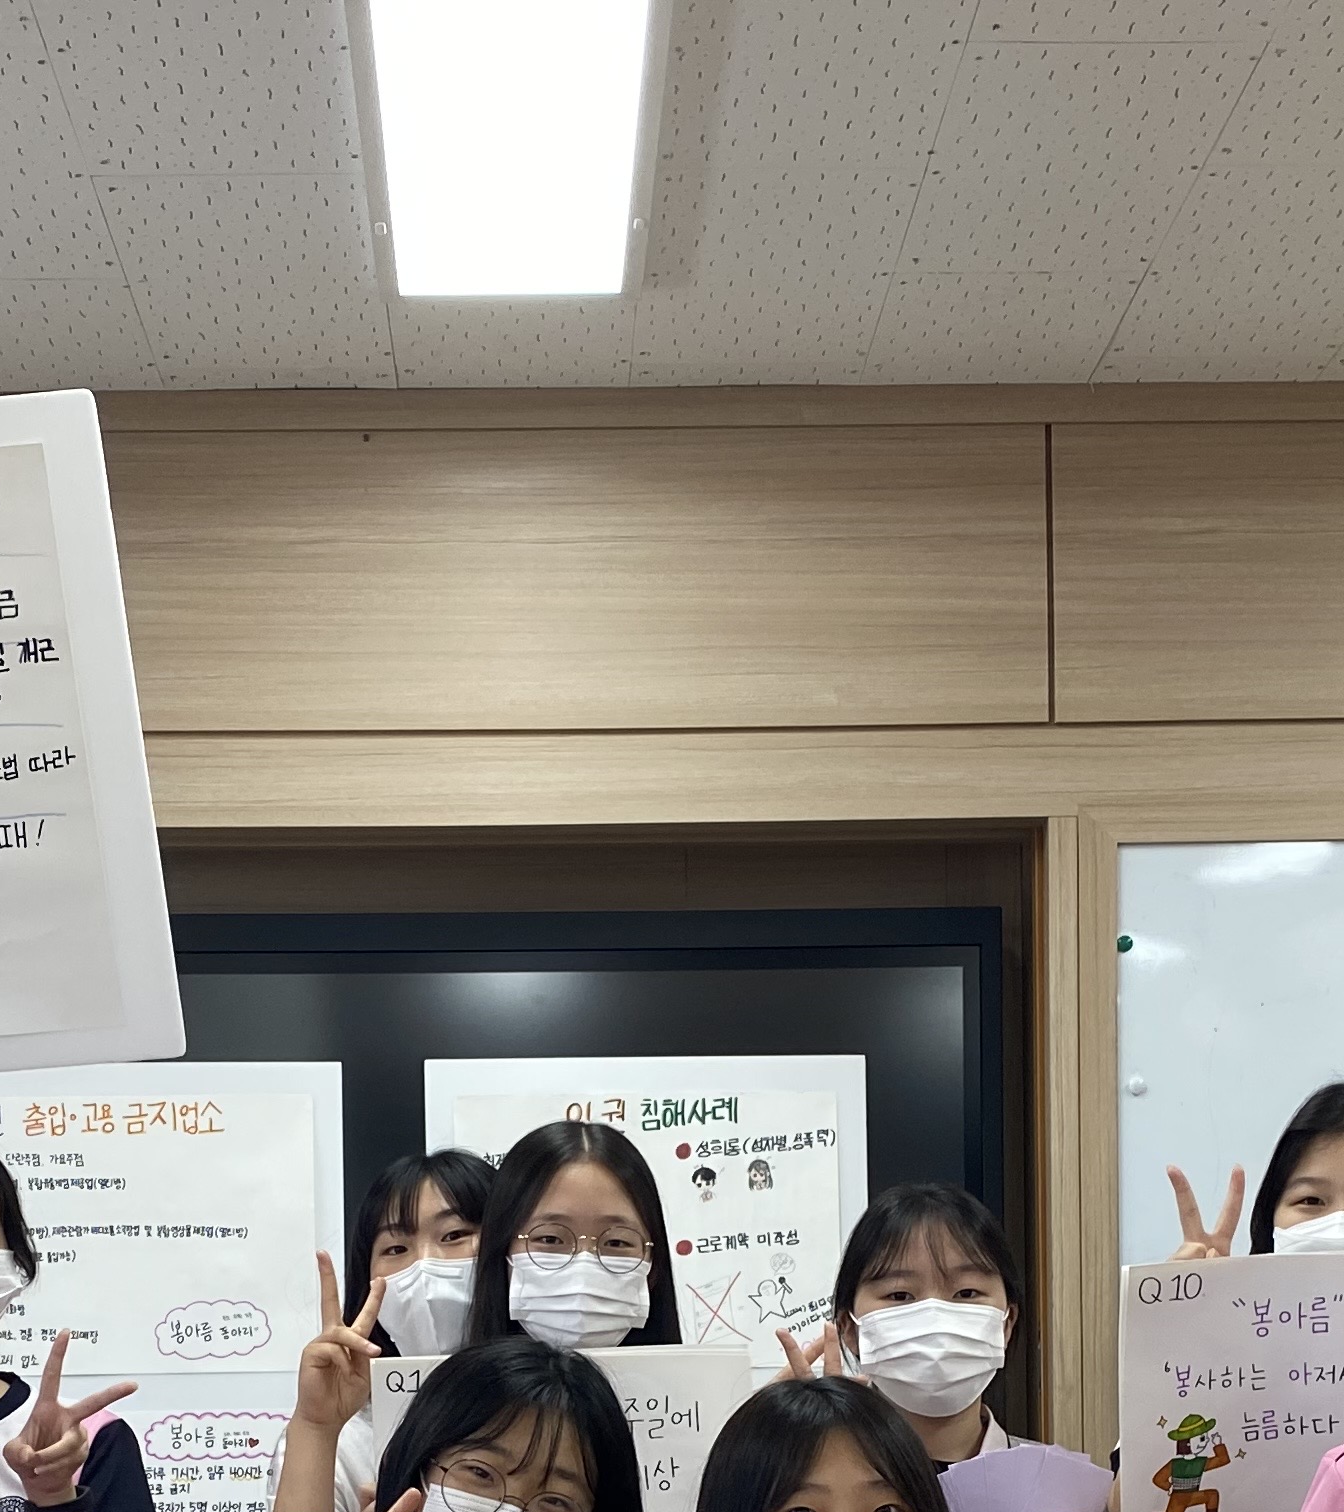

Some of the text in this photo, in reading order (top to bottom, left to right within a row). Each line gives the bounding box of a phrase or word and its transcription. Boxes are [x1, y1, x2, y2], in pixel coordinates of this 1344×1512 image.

[29, 746, 77, 772] 따라
[122, 1101, 225, 1135] 금지업소
[640, 1097, 740, 1131] 침해사례
[697, 1233, 749, 1254] 근로계약
[171, 1320, 213, 1344] 봉아름
[171, 1423, 216, 1450] 봉아름
[206, 1466, 262, 1480] 일주 40시간
[170, 1484, 190, 1495] 금지
